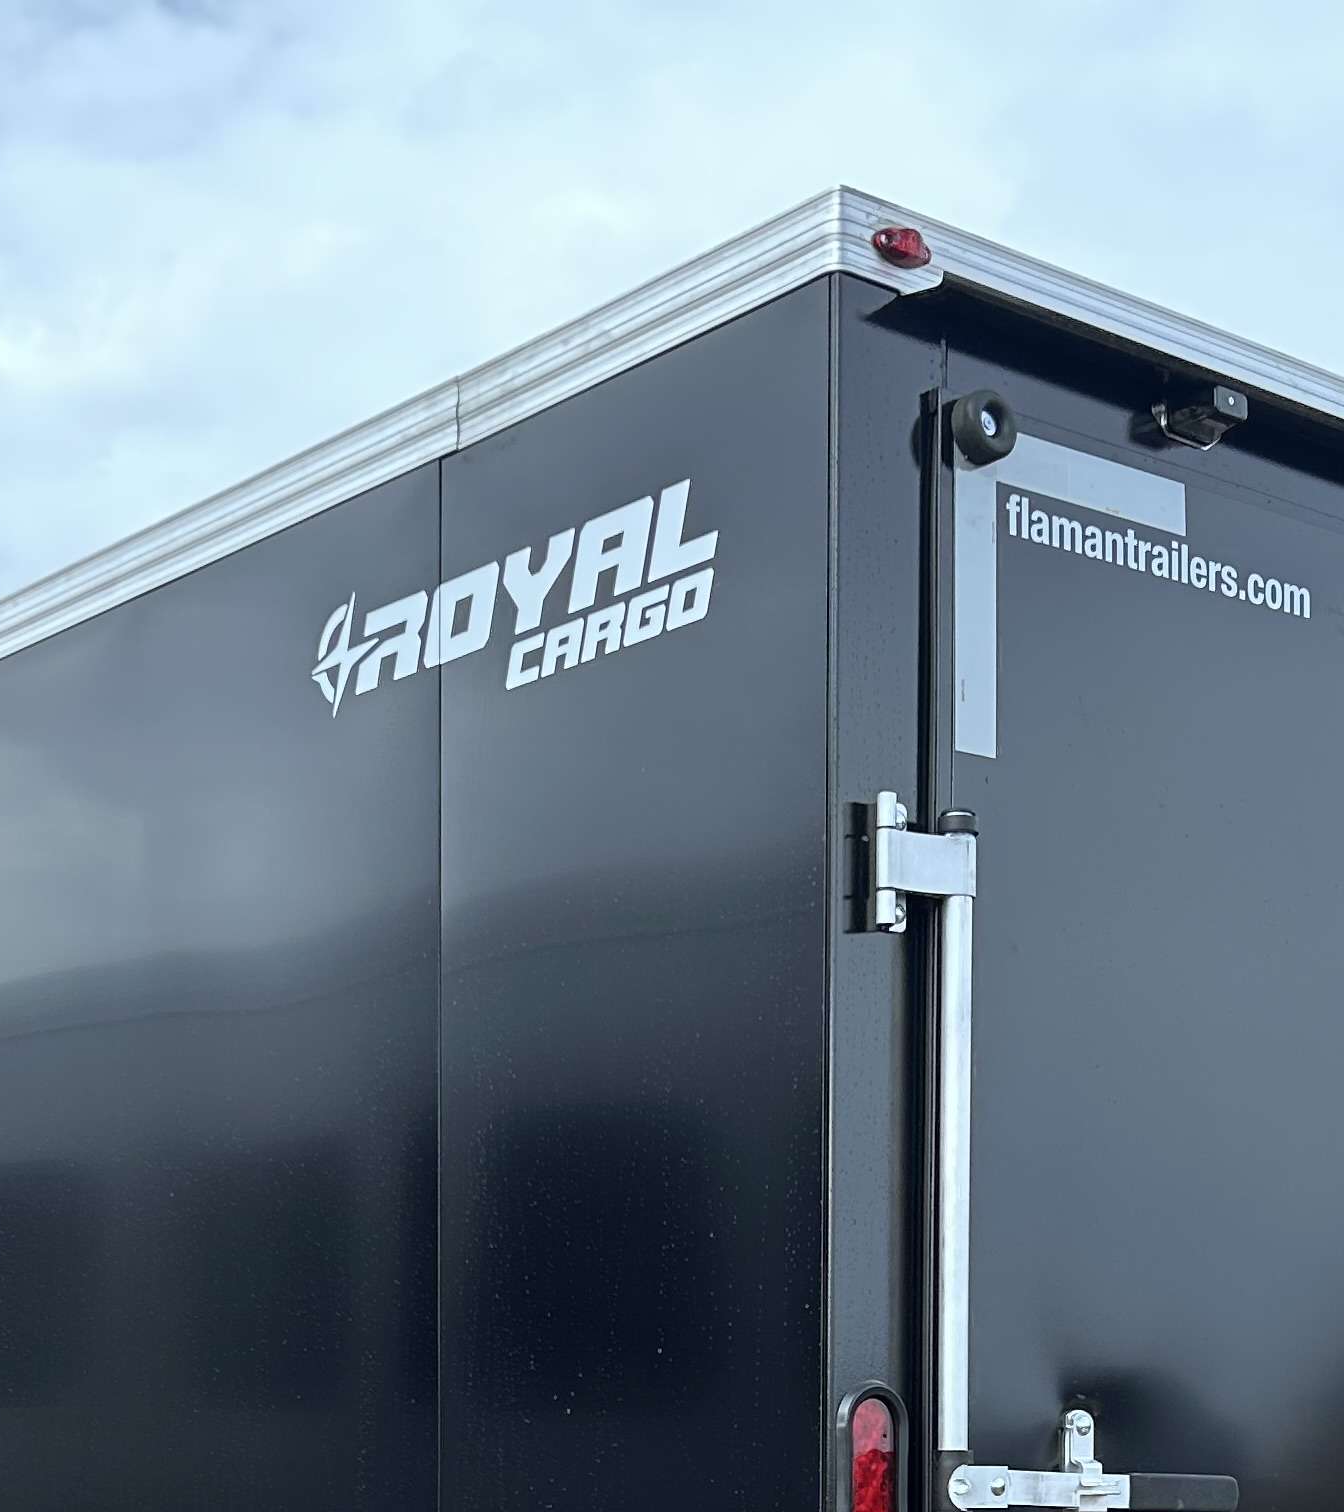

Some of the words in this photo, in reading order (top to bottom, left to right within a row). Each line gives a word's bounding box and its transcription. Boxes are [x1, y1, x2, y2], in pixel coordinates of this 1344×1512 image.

[355, 478, 719, 696] ROYAL
[1006, 494, 1312, 619] flamantrailers.com
[506, 567, 714, 690] CARGO
